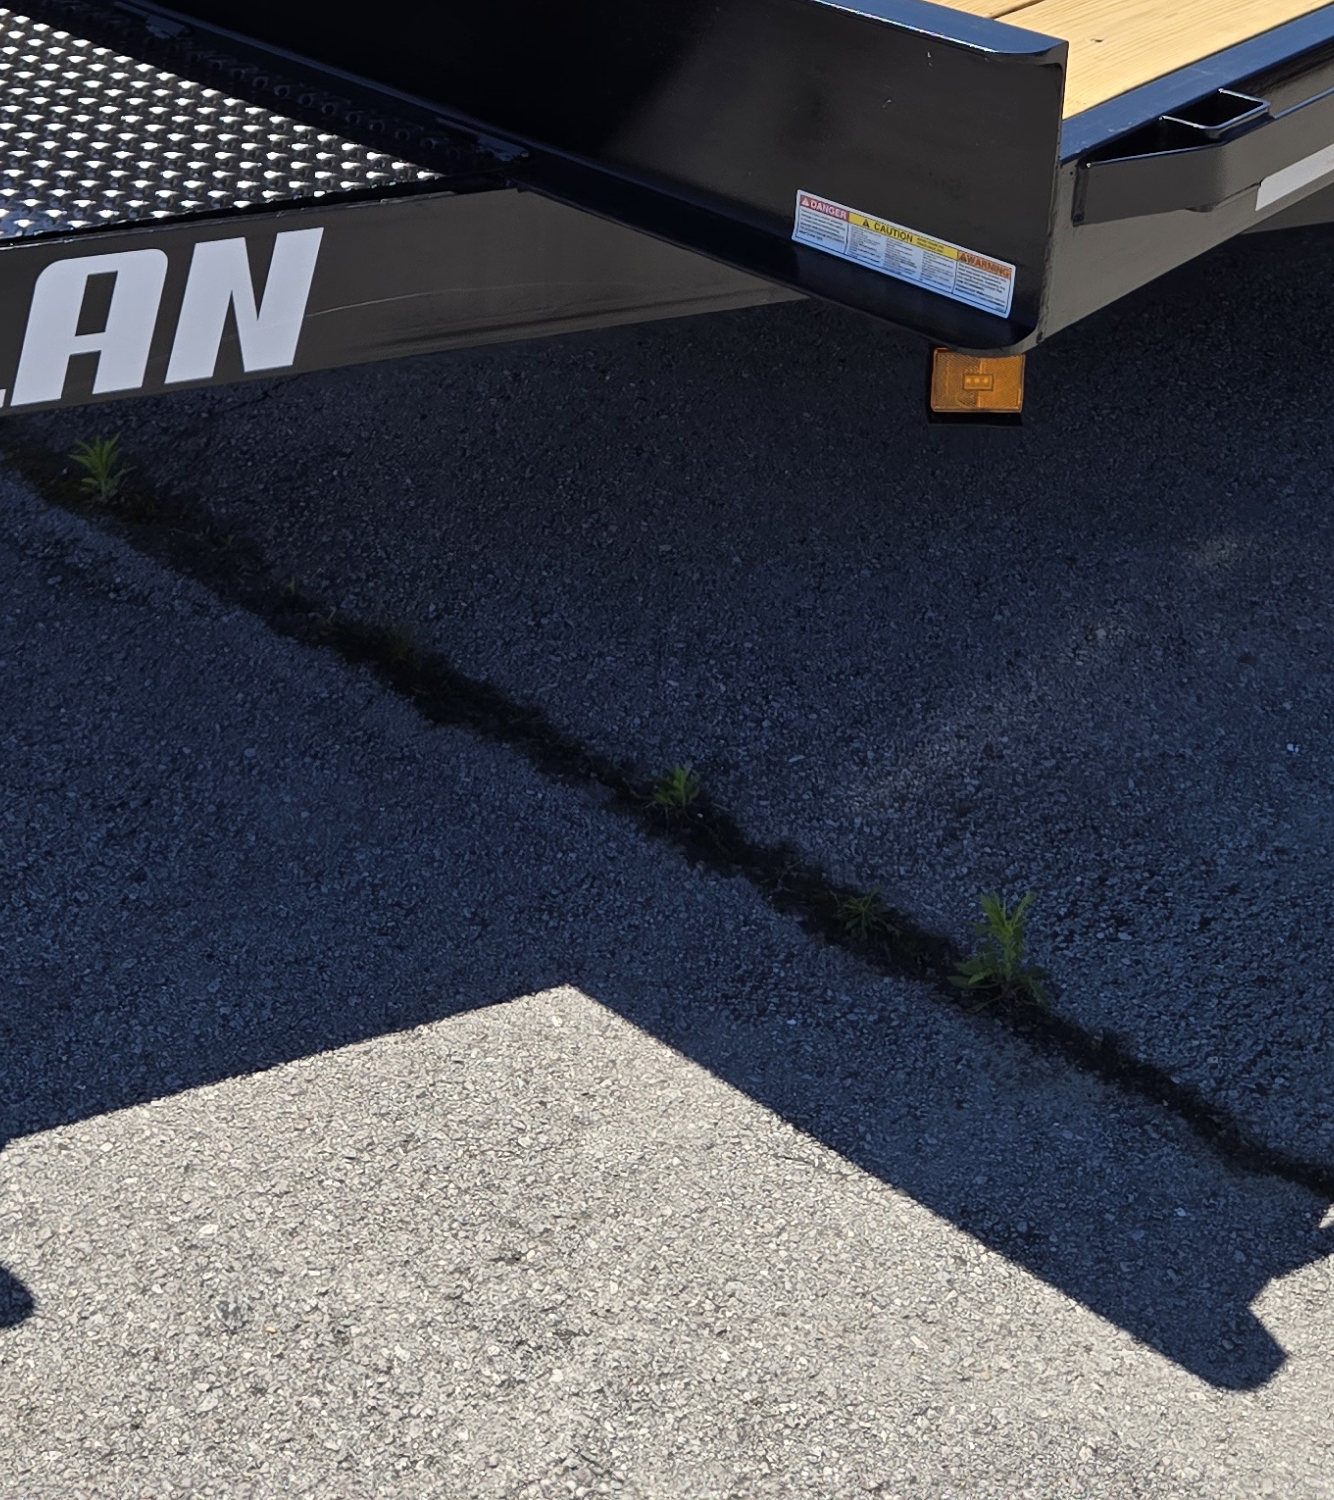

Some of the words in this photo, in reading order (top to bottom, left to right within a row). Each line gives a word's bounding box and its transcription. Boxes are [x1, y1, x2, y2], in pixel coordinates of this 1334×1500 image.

[810, 199, 847, 220] DANGER
[874, 222, 913, 243] CAUTION
[967, 253, 1011, 277] WARNING
